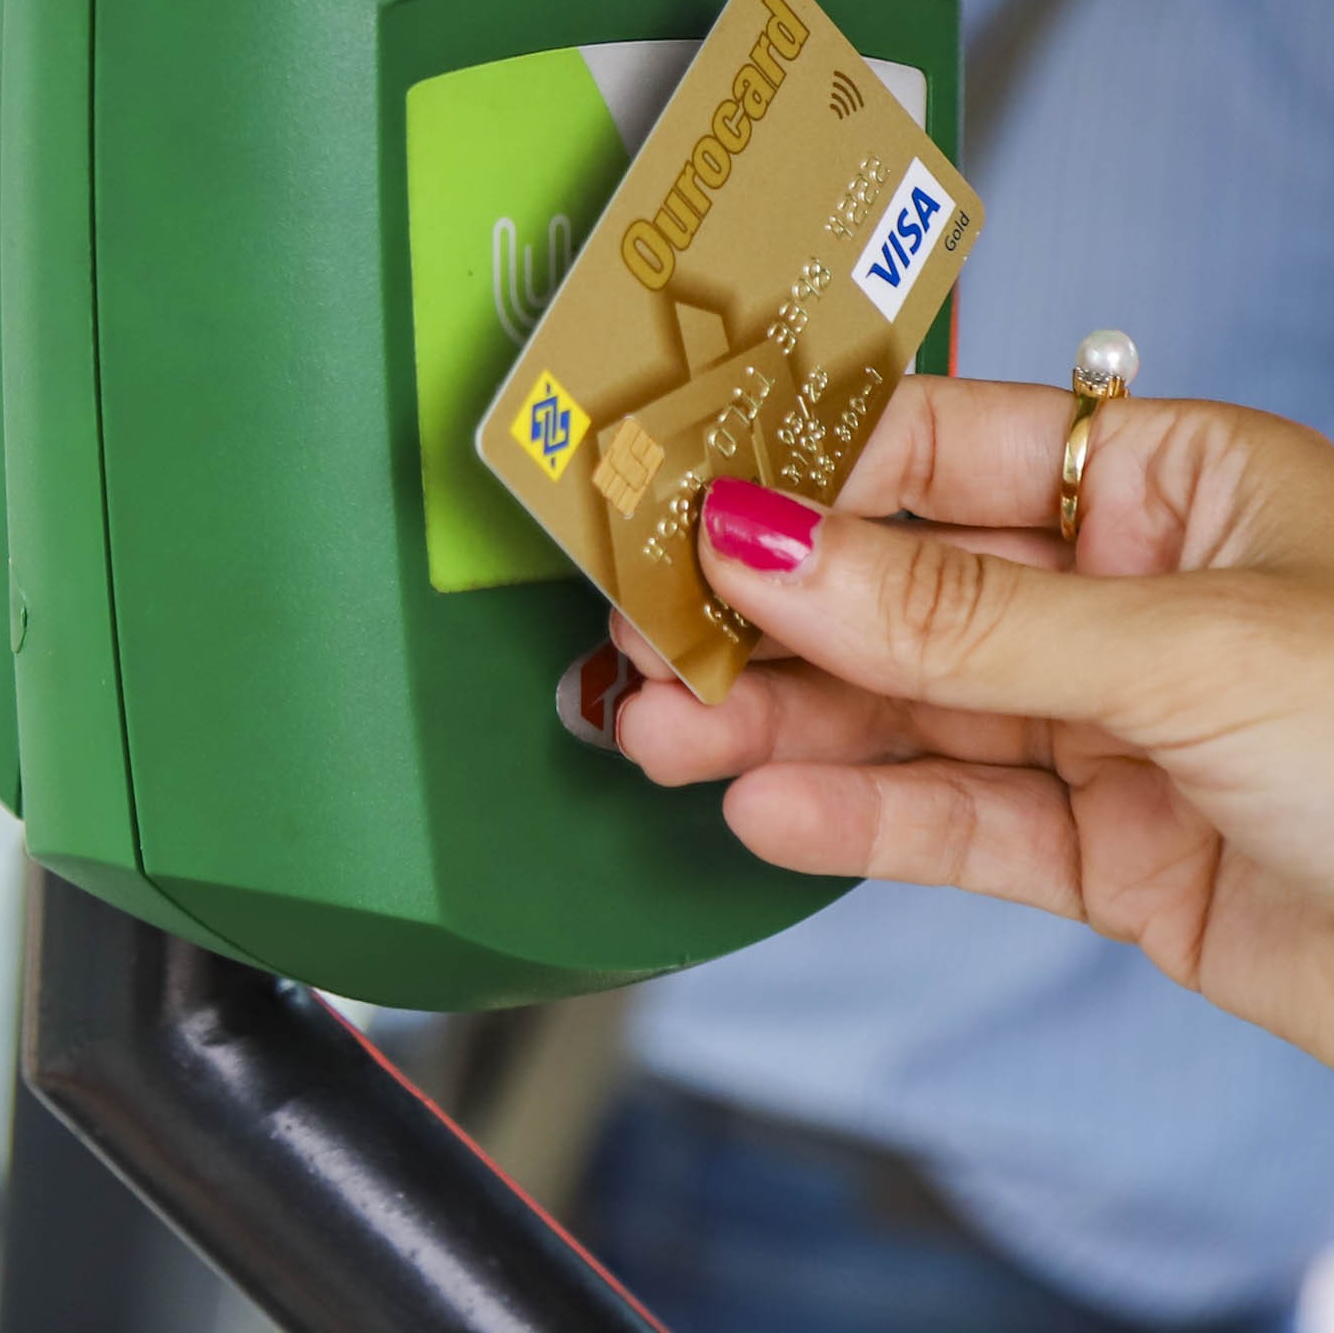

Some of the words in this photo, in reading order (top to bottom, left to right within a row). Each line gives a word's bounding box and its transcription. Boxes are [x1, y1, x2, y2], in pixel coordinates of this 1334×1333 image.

[824, 153, 891, 242] 4222
[866, 186, 942, 288] VISA
[944, 210, 971, 252] Gold
